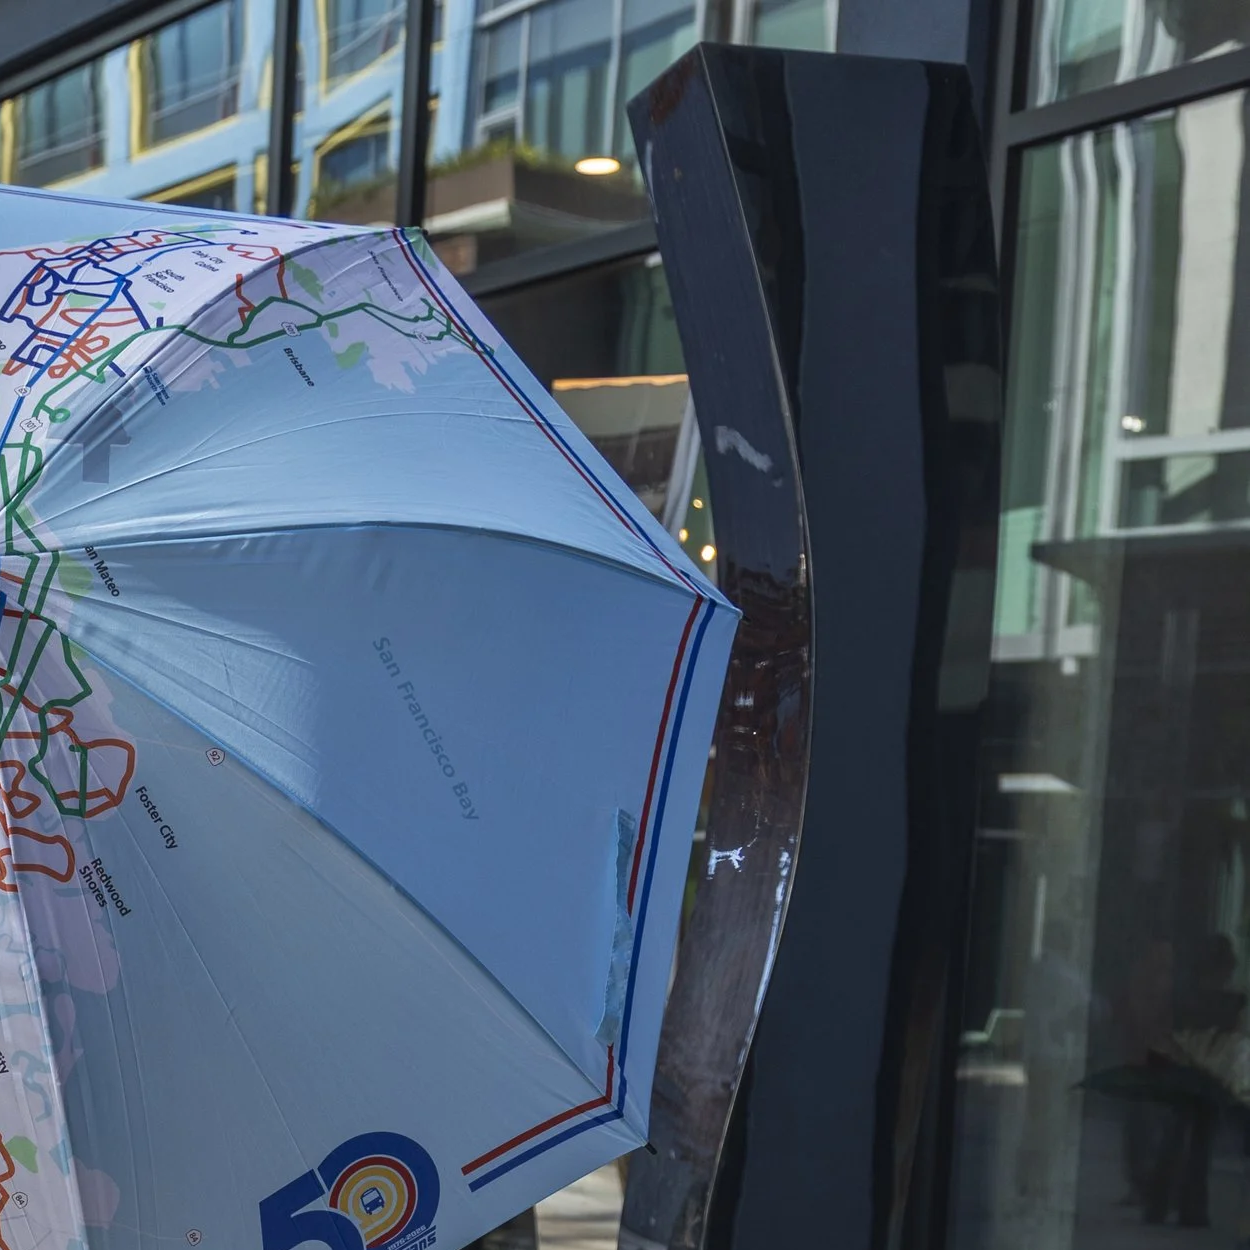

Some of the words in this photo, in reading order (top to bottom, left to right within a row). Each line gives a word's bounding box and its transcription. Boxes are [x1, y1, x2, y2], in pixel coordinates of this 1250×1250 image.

[142, 274, 174, 293] Francisco
[152, 271, 168, 280] San
[162, 269, 185, 281] South
[283, 347, 314, 386] Brisbane
[94, 560, 120, 597] Mateo
[372, 636, 400, 678] San
[397, 681, 455, 778] Francisco
[452, 782, 479, 821] Bay
[210, 751, 221, 762] 92
[135, 786, 163, 823] Foster
[159, 824, 178, 850] City
[79, 866, 107, 908] Shores
[91, 858, 132, 917] Redwood
[14, 1195, 24, 1206] 84
